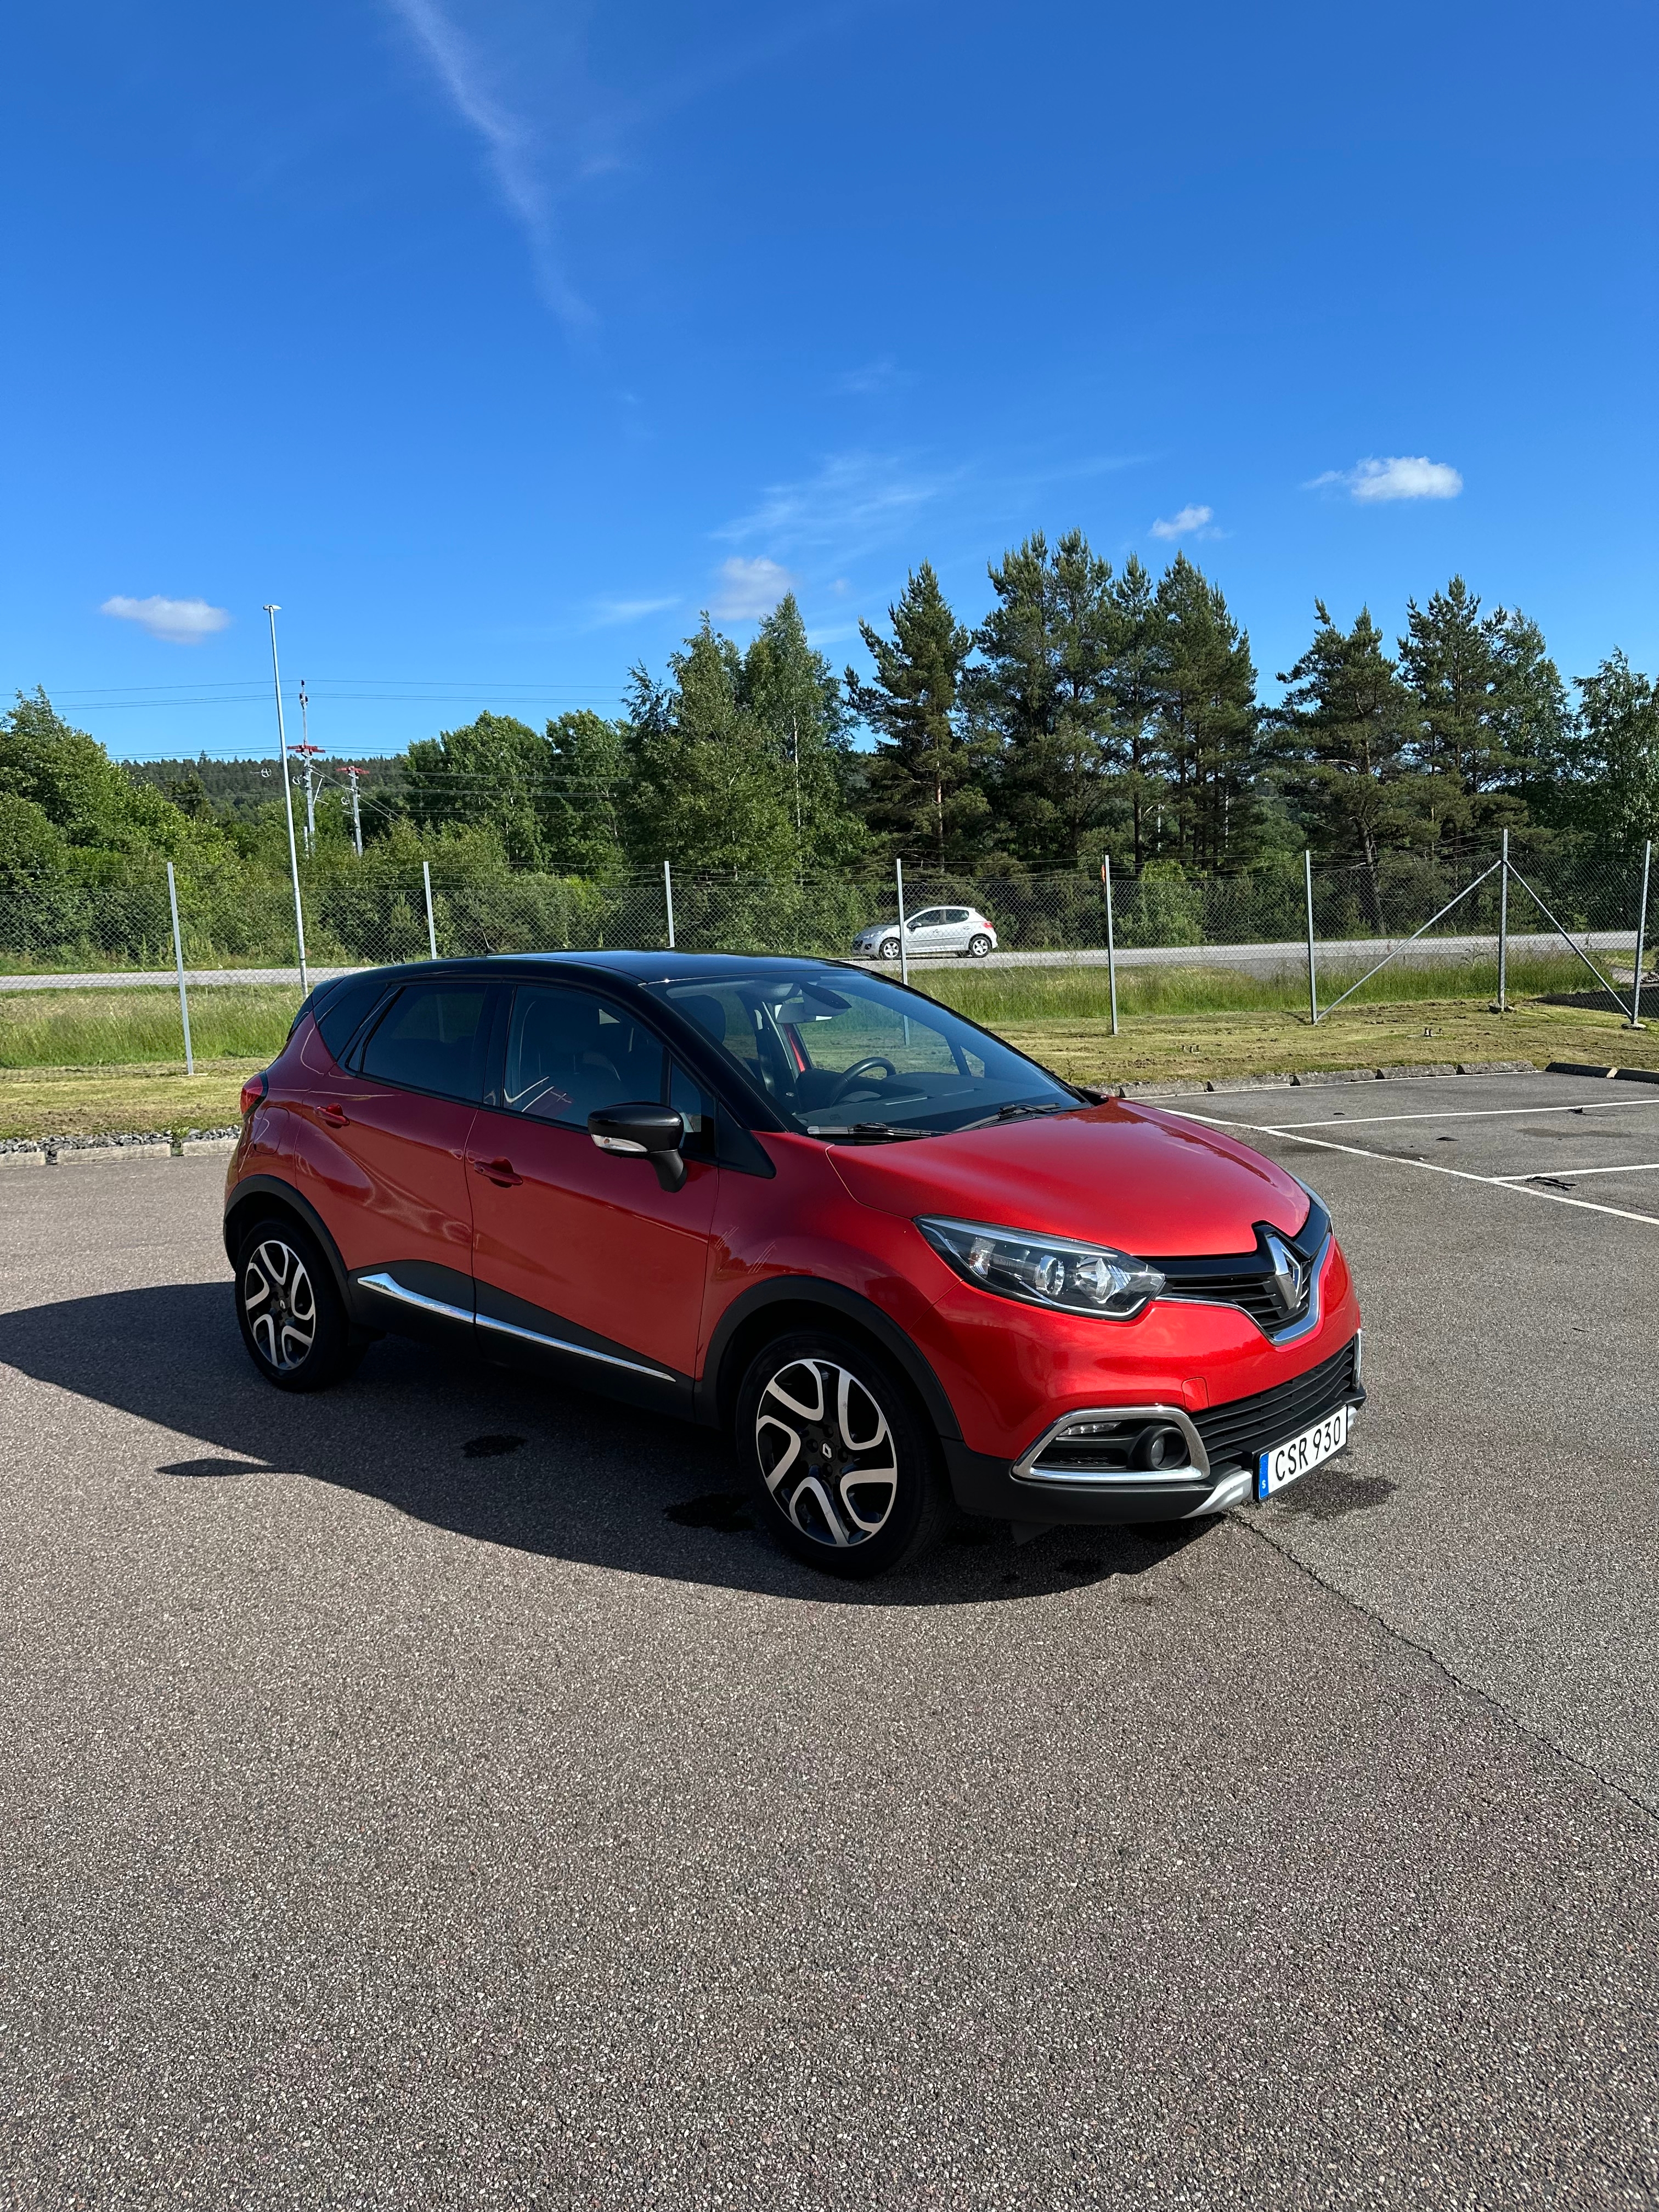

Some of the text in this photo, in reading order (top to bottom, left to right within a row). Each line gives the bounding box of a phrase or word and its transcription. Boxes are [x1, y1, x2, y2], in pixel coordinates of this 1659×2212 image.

[1276, 1416, 1341, 1481] CSR 930
[1262, 1480, 1266, 1489] S
